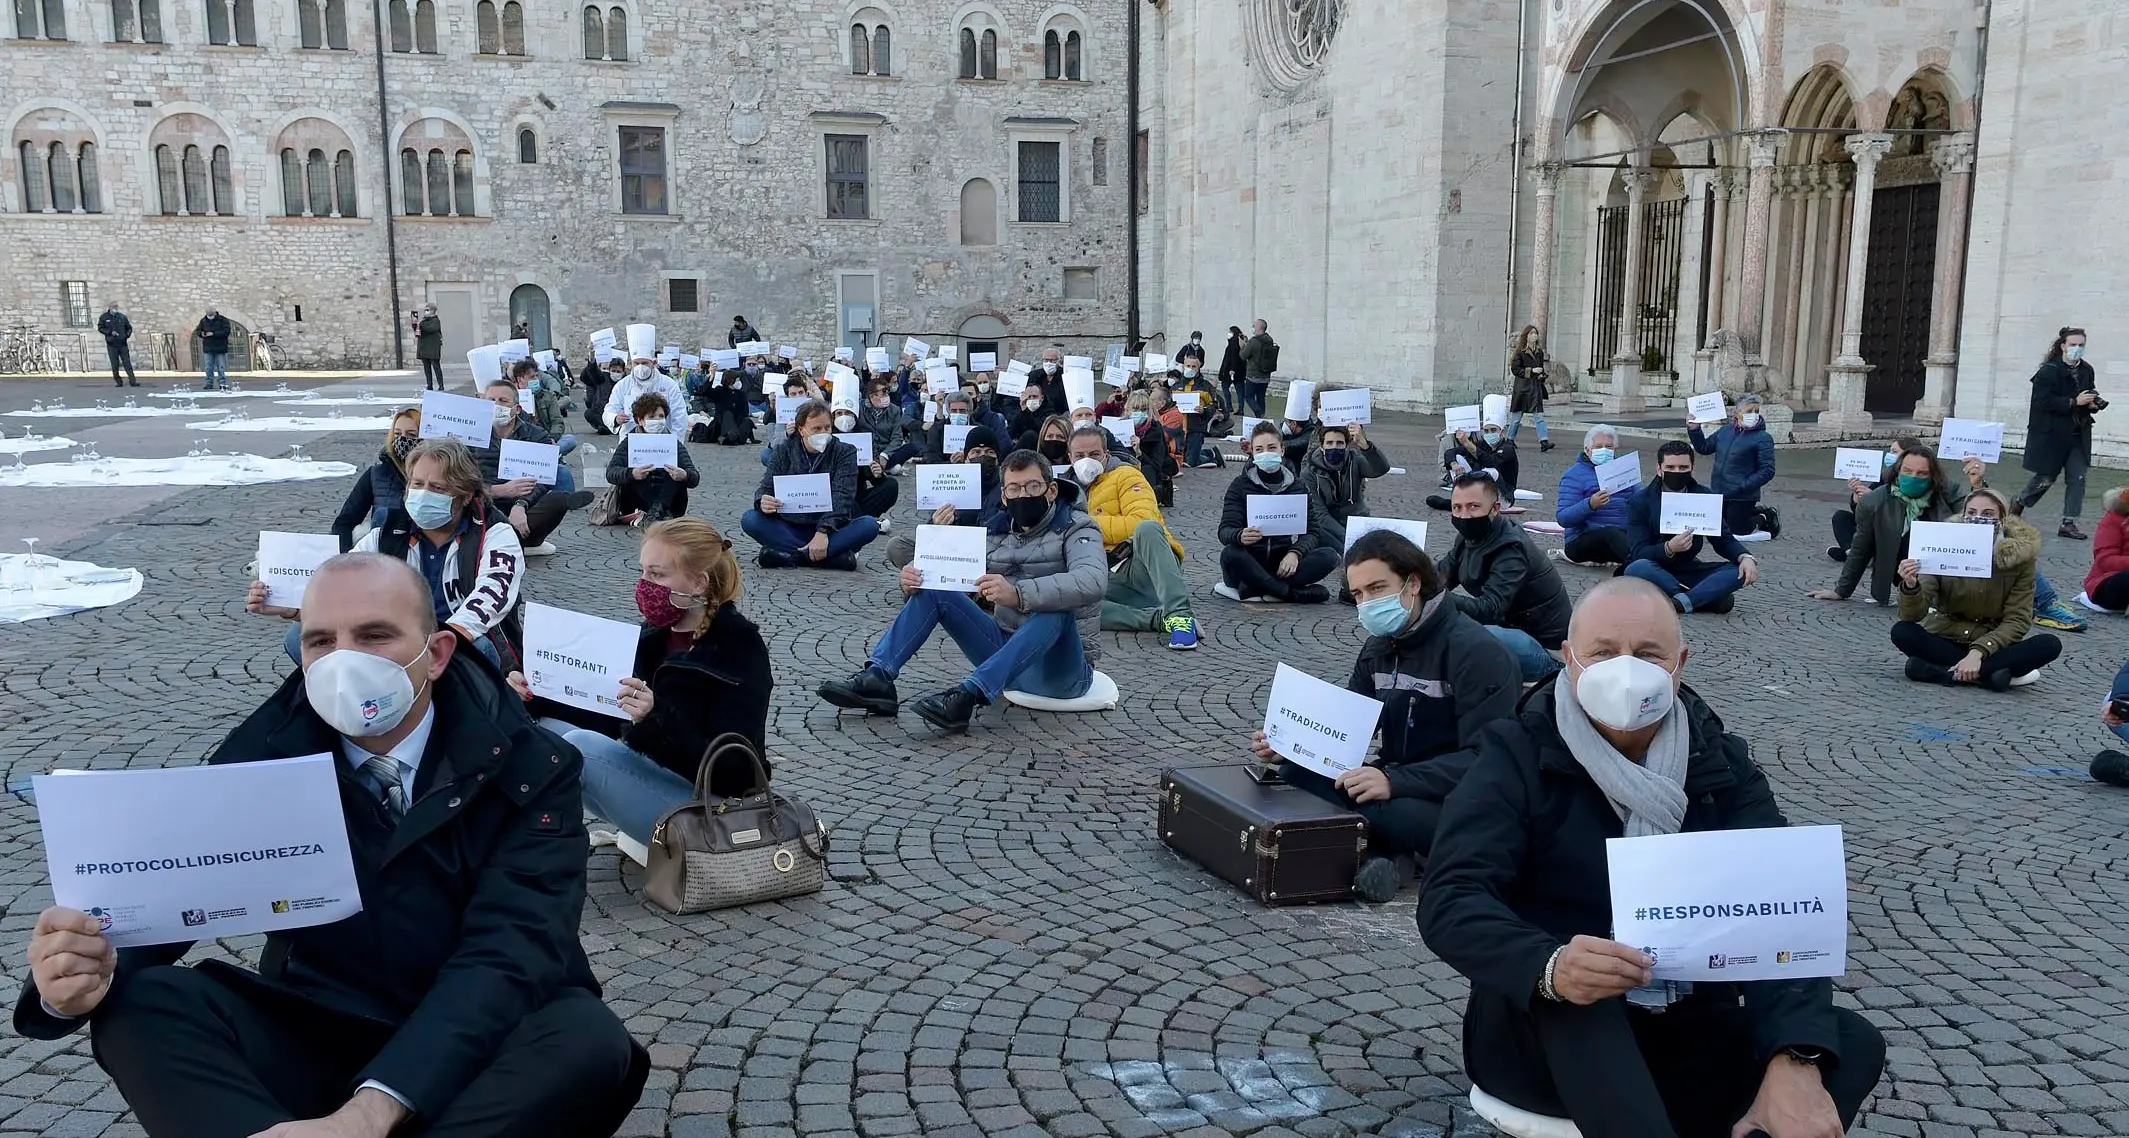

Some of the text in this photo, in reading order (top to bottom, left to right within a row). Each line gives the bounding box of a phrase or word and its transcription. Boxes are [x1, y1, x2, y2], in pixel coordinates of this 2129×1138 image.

[432, 413, 477, 426] #CAMERIERI
[1950, 436, 1991, 445] #TRADIZIONE
[504, 456, 552, 468] #IMPRENDITORI
[1921, 546, 1977, 555] #TRADIZIONE
[268, 567, 314, 577] #DISCOTEC
[536, 649, 607, 675] #RISTORANTI
[1280, 707, 1348, 742] #TRADIZIONE
[75, 843, 324, 876] #PROTOCOLLIDISICUREZZA
[1635, 897, 1824, 921] #RESPONSABILITÀ
